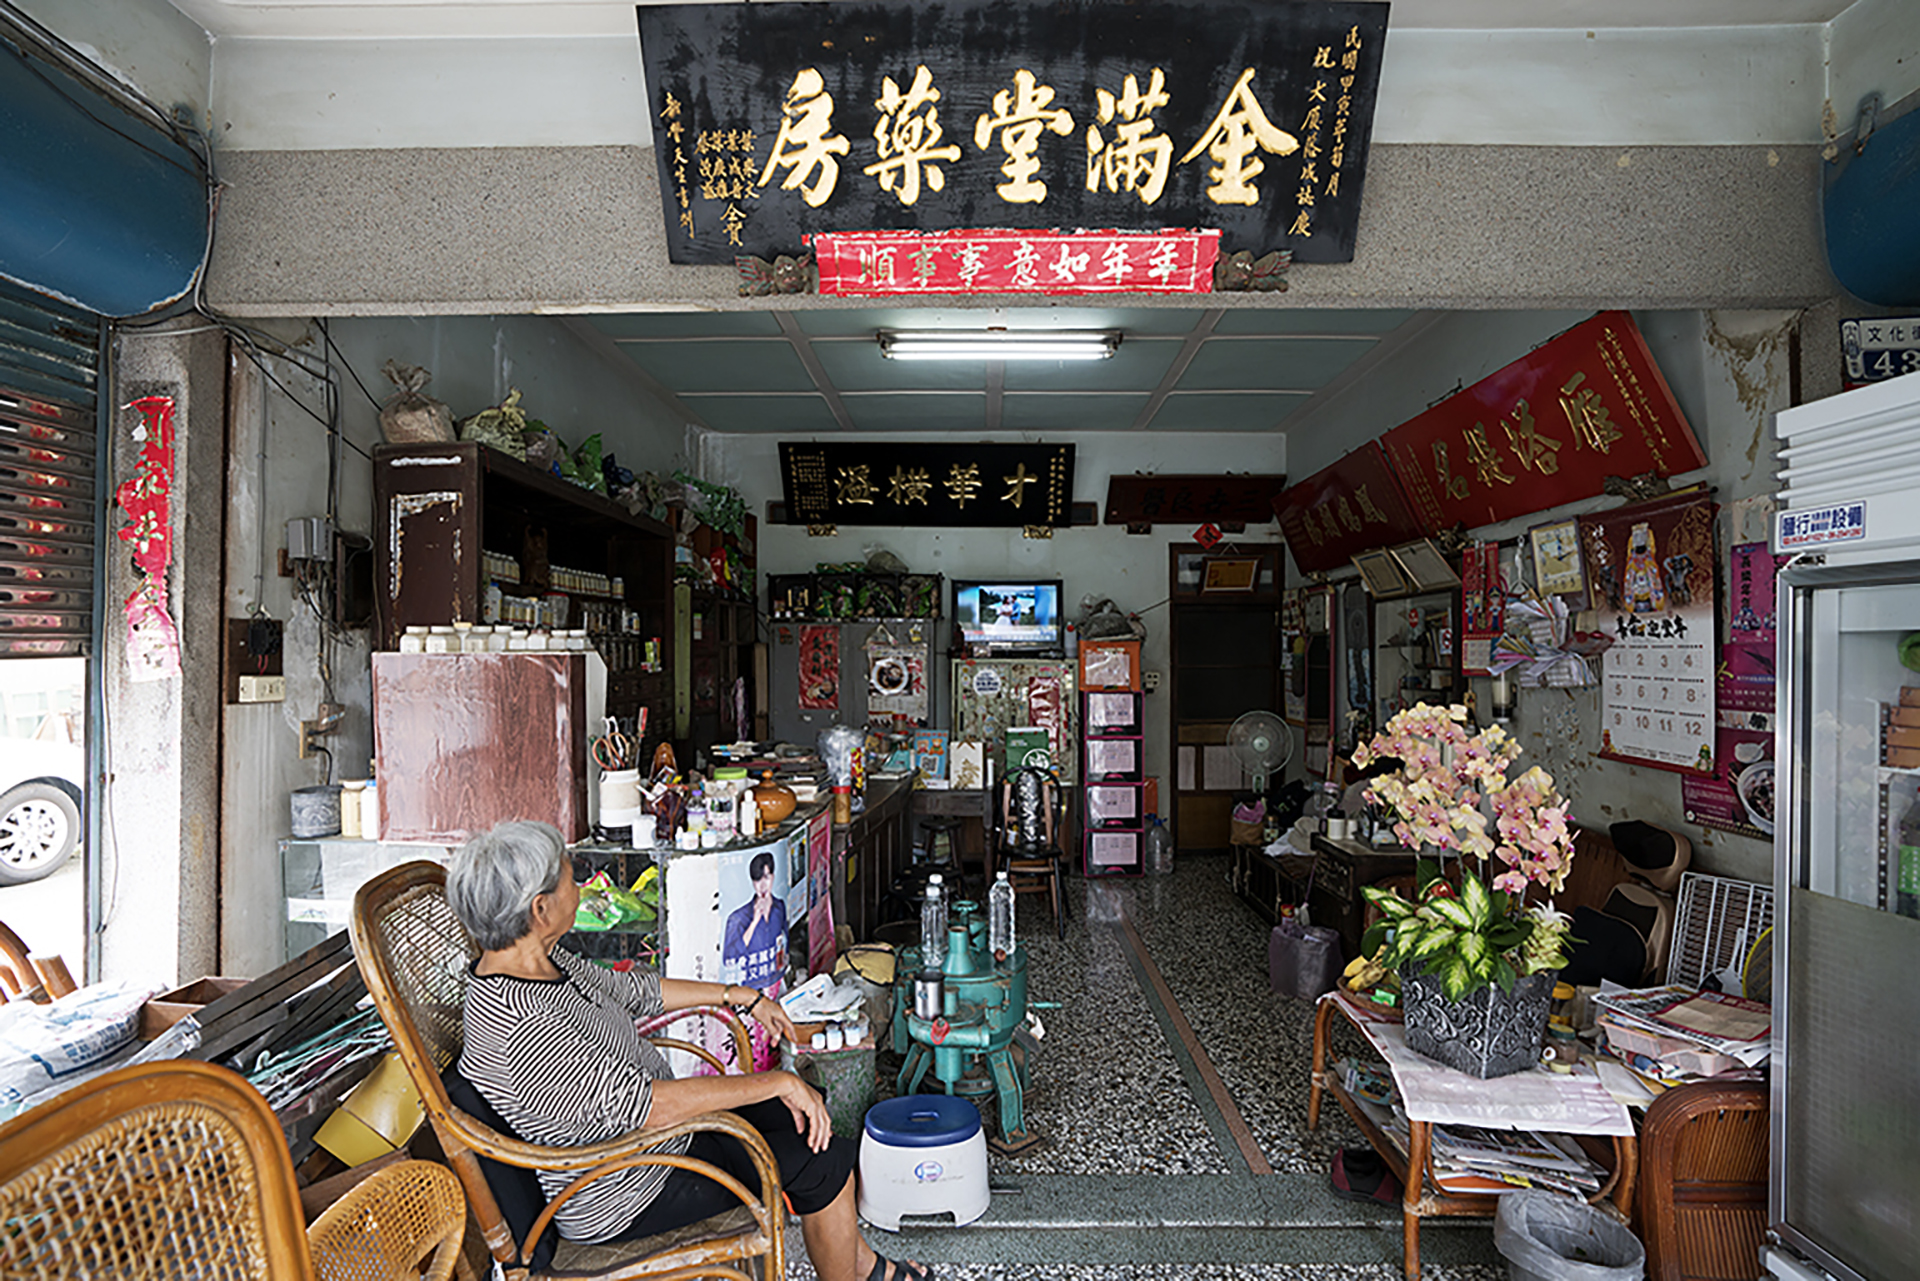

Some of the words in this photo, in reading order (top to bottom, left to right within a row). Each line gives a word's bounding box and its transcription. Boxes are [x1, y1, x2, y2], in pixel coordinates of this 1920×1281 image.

[757, 66, 1300, 207] 金滿堂藥房
[859, 240, 1180, 287] 年年如意事事順
[1615, 653, 1621, 665] 1
[1636, 653, 1644, 666] 2
[1660, 654, 1668, 668] 3
[1683, 654, 1693, 668] 4
[1615, 683, 1622, 696] 5
[1637, 685, 1645, 698] 6
[1661, 686, 1668, 700] 7
[1686, 688, 1696, 702] 8
[1614, 712, 1622, 725] 9
[1636, 715, 1650, 729] 10
[1659, 718, 1672, 732] 11
[1685, 721, 1702, 736] 12
